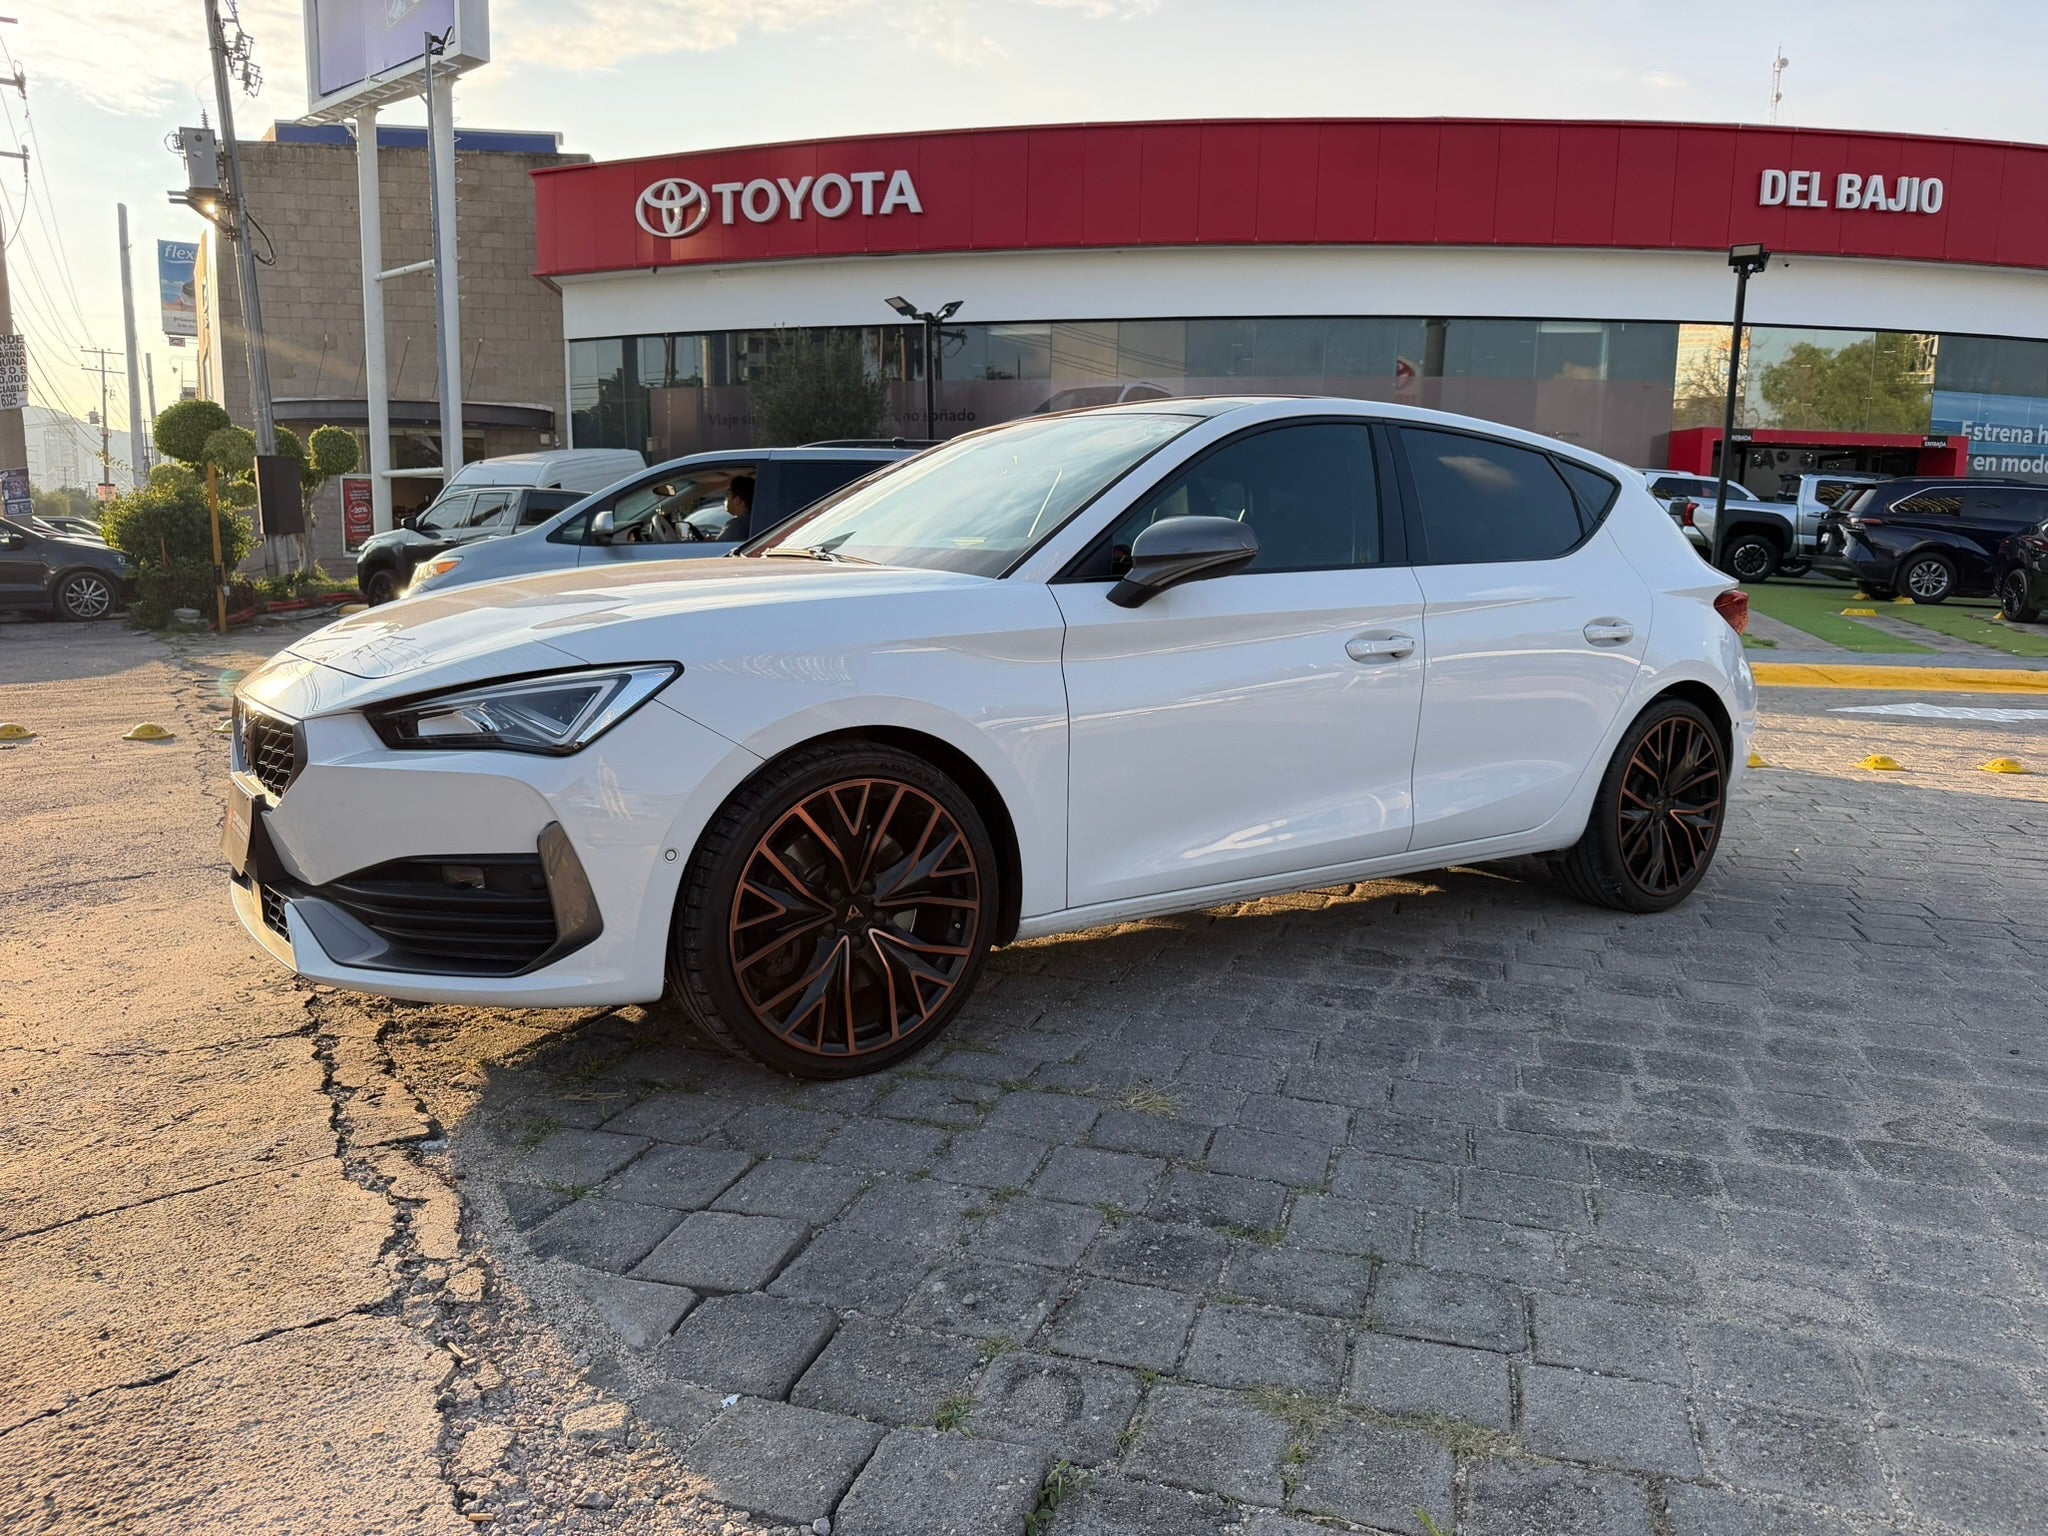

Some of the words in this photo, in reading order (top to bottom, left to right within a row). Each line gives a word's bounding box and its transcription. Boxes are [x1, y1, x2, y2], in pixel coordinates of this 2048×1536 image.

[712, 170, 923, 225] TOYOTA
[1759, 169, 1828, 207] DEL
[1835, 173, 1944, 214] BAJIO
[164, 244, 195, 260] flex
[0, 358, 26, 367] UINA
[1961, 420, 2033, 444] Estrena
[1973, 456, 1997, 471] en
